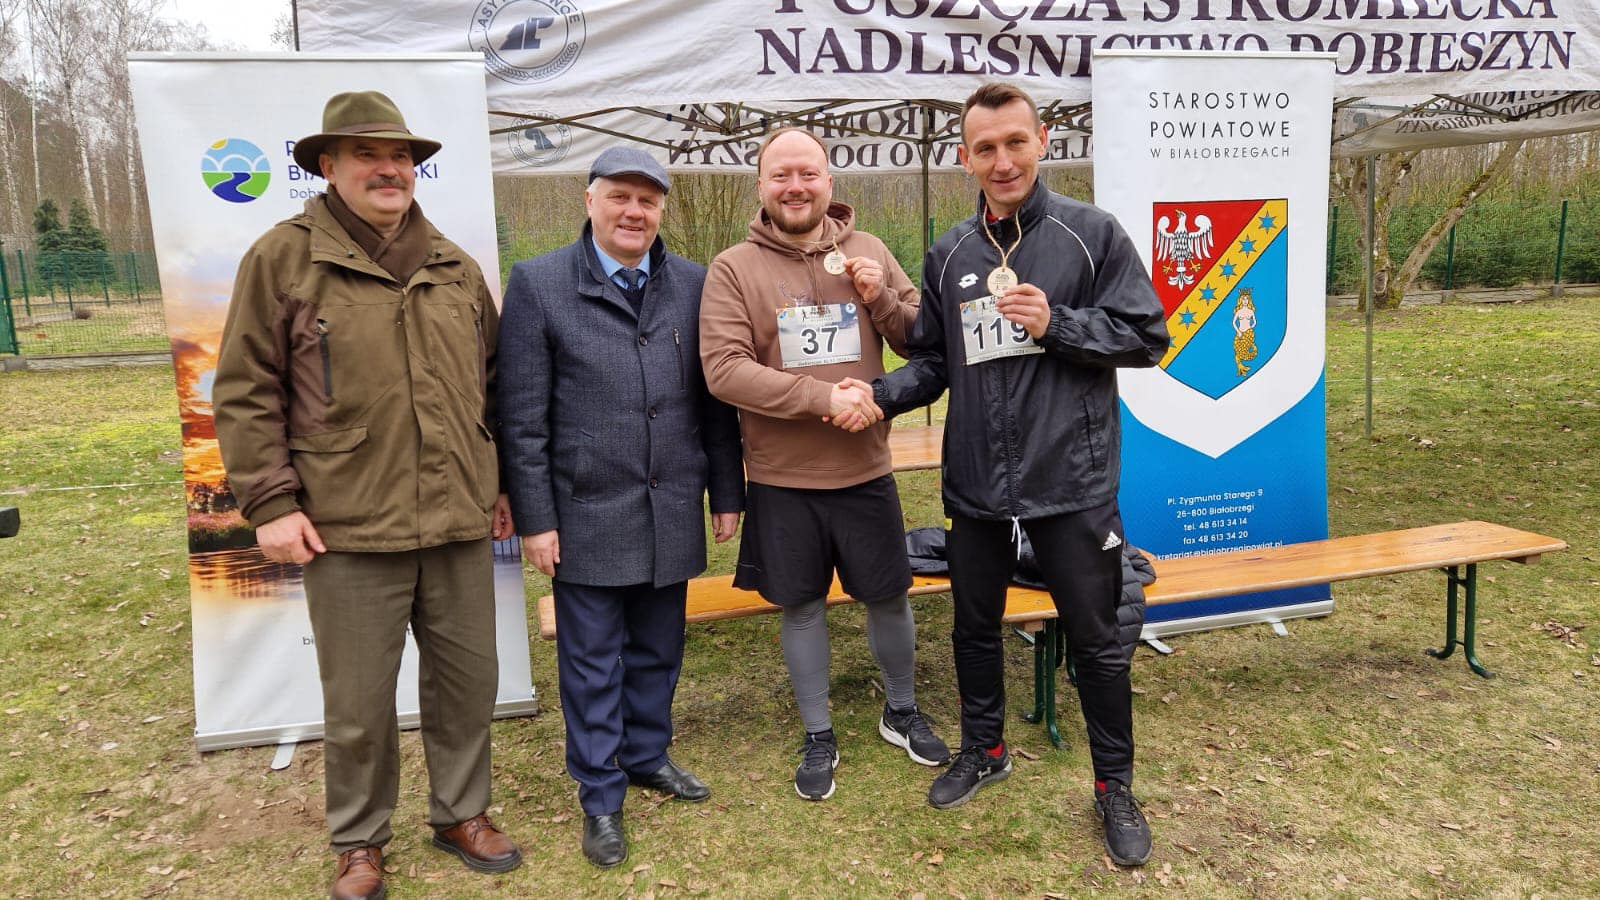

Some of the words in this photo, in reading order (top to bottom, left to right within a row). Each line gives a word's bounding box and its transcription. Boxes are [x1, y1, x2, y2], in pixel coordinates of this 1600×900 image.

[1149, 91, 1290, 109] STAROSTWO
[1150, 121, 1290, 139] POWIATOWE
[1150, 147, 1161, 158] W
[1170, 146, 1290, 159] BIAŁOBRZEGACH
[801, 326, 838, 355] 37
[972, 317, 1031, 350] 119
[1167, 497, 1177, 506] Pl.
[1179, 494, 1222, 506] Zygmunta
[1223, 489, 1256, 501] Starego
[1257, 488, 1264, 497] 9
[1176, 507, 1207, 519] 26-800
[1209, 503, 1255, 516] Białobrzegi
[1183, 523, 1196, 531] tel.
[1198, 521, 1210, 530] 48
[1211, 520, 1225, 529] 613
[1226, 518, 1237, 527] 34
[1239, 517, 1248, 525] 14
[1183, 536, 1196, 545] fax
[1198, 535, 1209, 543] 48
[1211, 533, 1224, 542] 613
[1226, 532, 1236, 541] 34
[1238, 530, 1249, 539] 20
